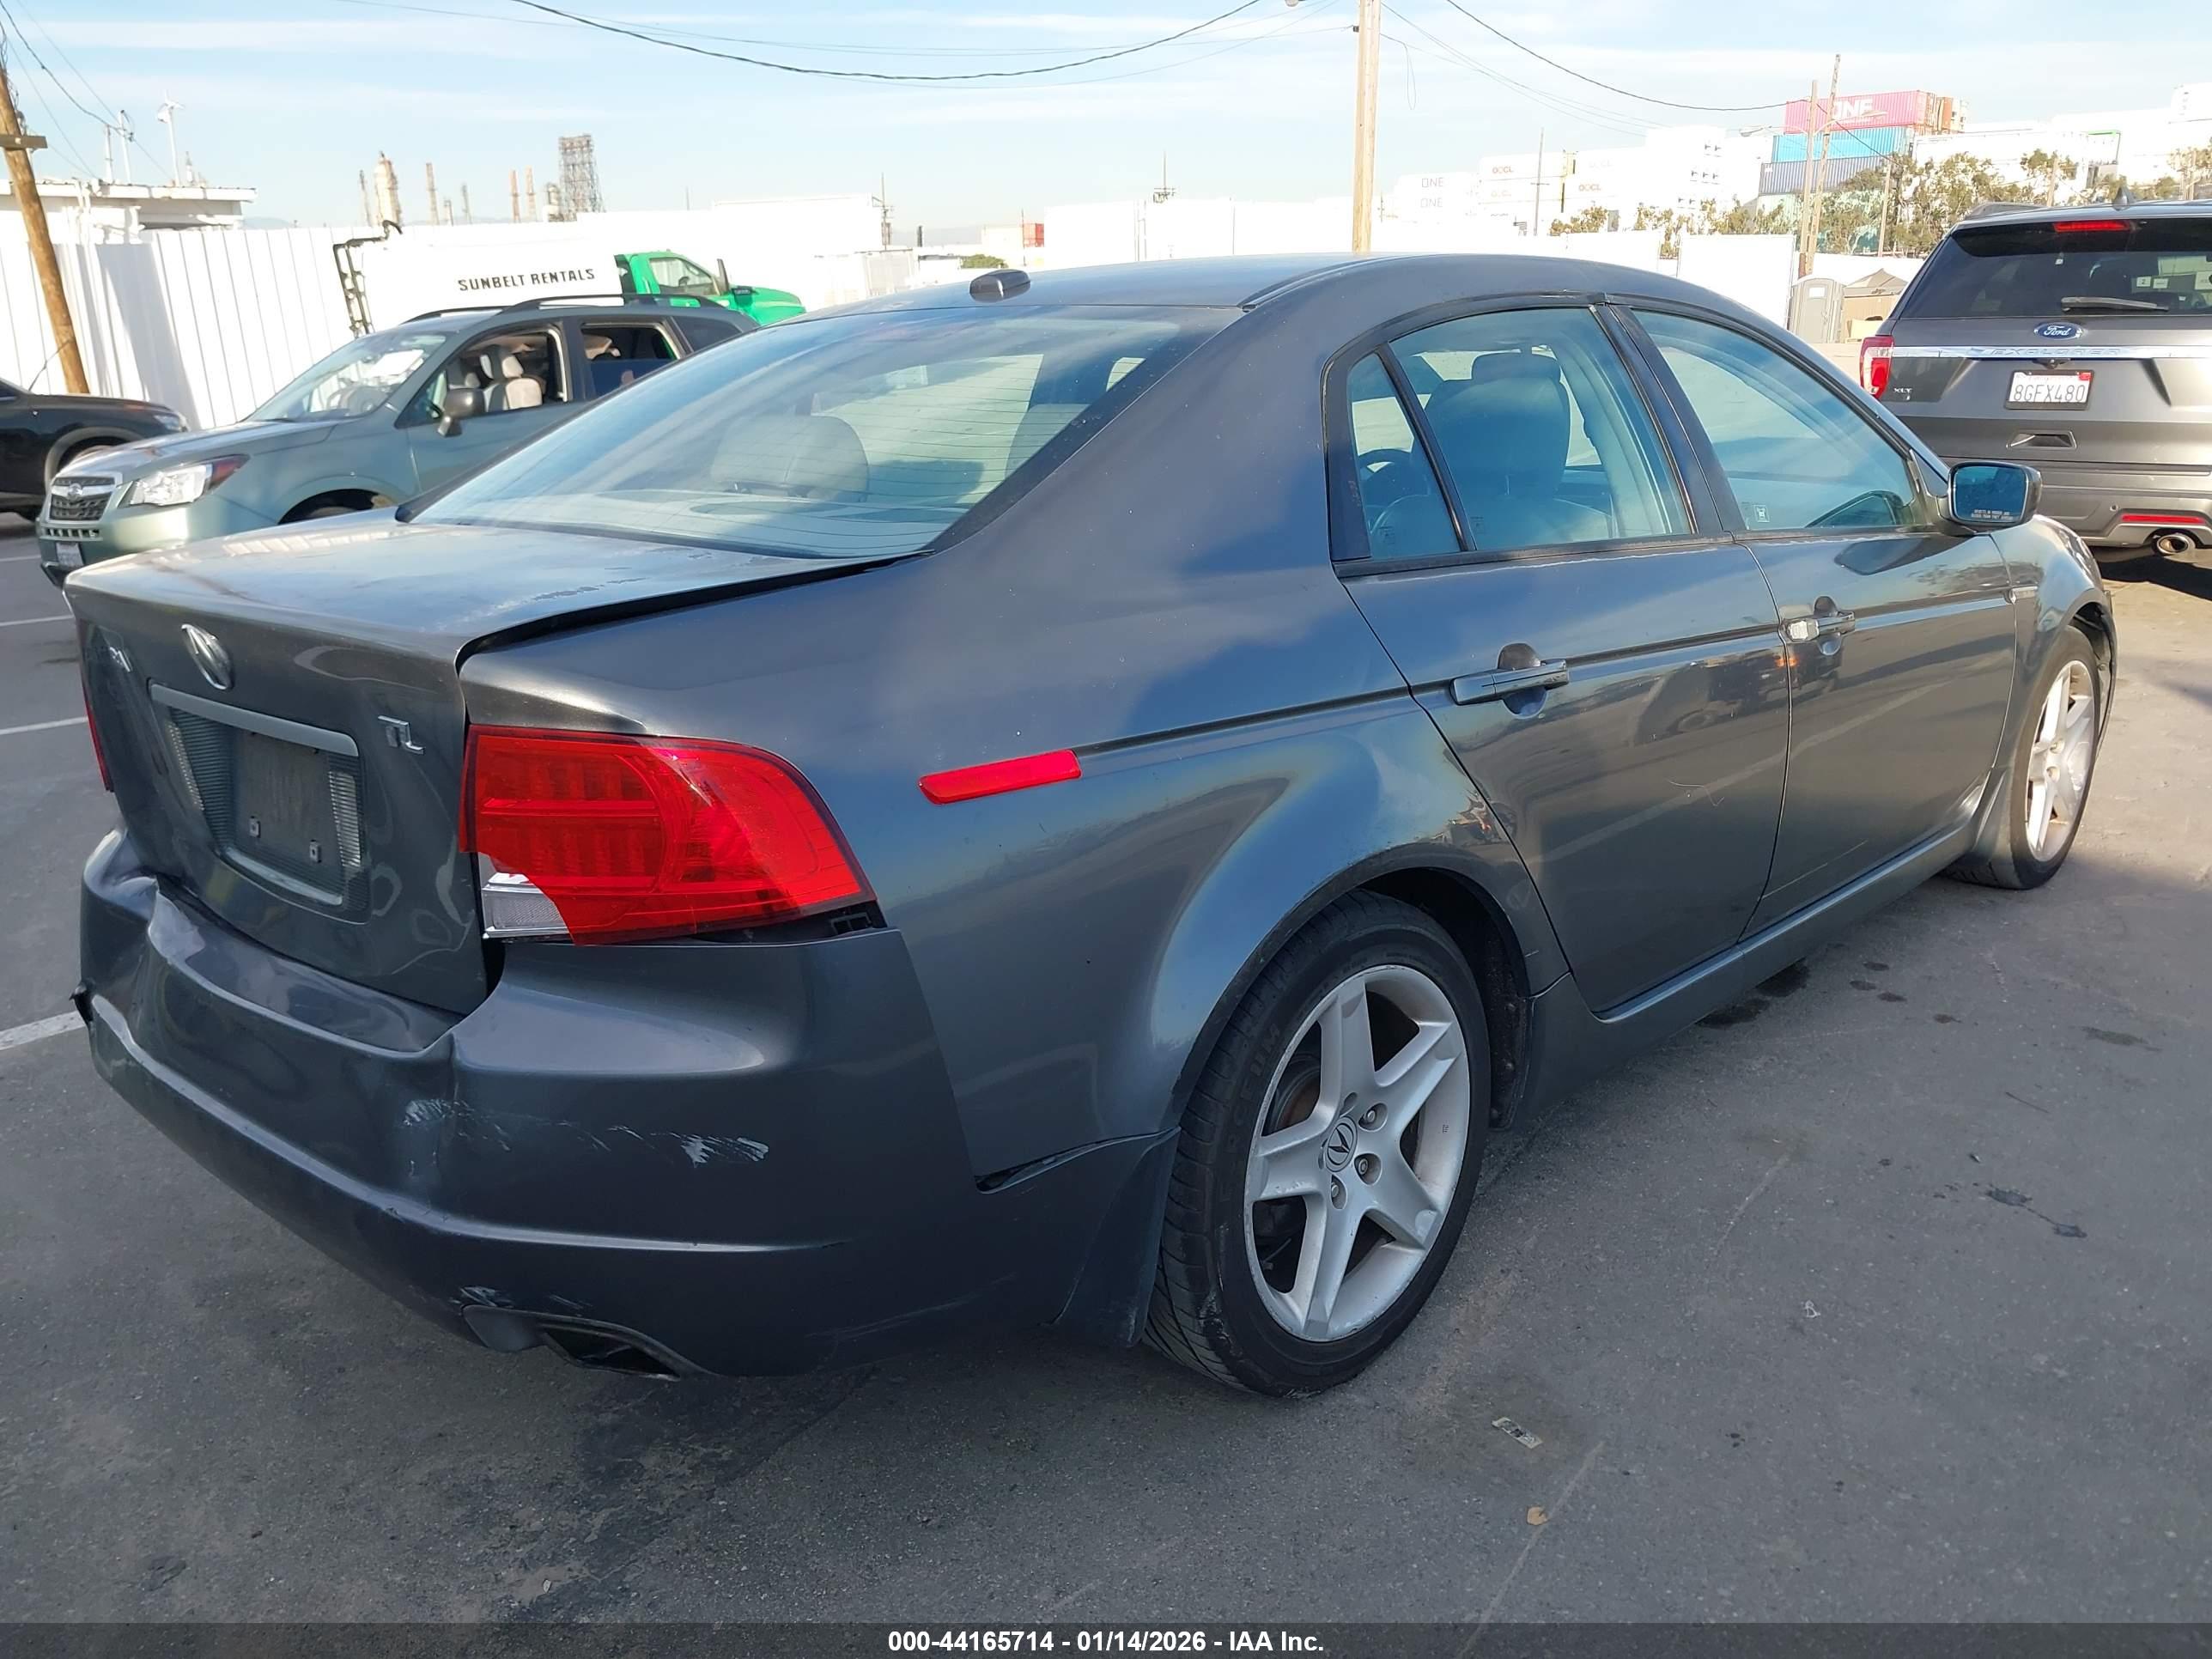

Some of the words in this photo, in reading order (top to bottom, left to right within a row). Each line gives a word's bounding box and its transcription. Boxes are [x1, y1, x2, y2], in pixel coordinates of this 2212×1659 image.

[1421, 178, 1443, 188] ONE
[1420, 198, 1443, 208] ONE
[458, 275, 525, 292] SUNBELT
[531, 269, 595, 284] RENTALS
[2044, 325, 2069, 336] Ford
[2014, 384, 2086, 402] 8GFX480
[378, 714, 424, 755] TL
